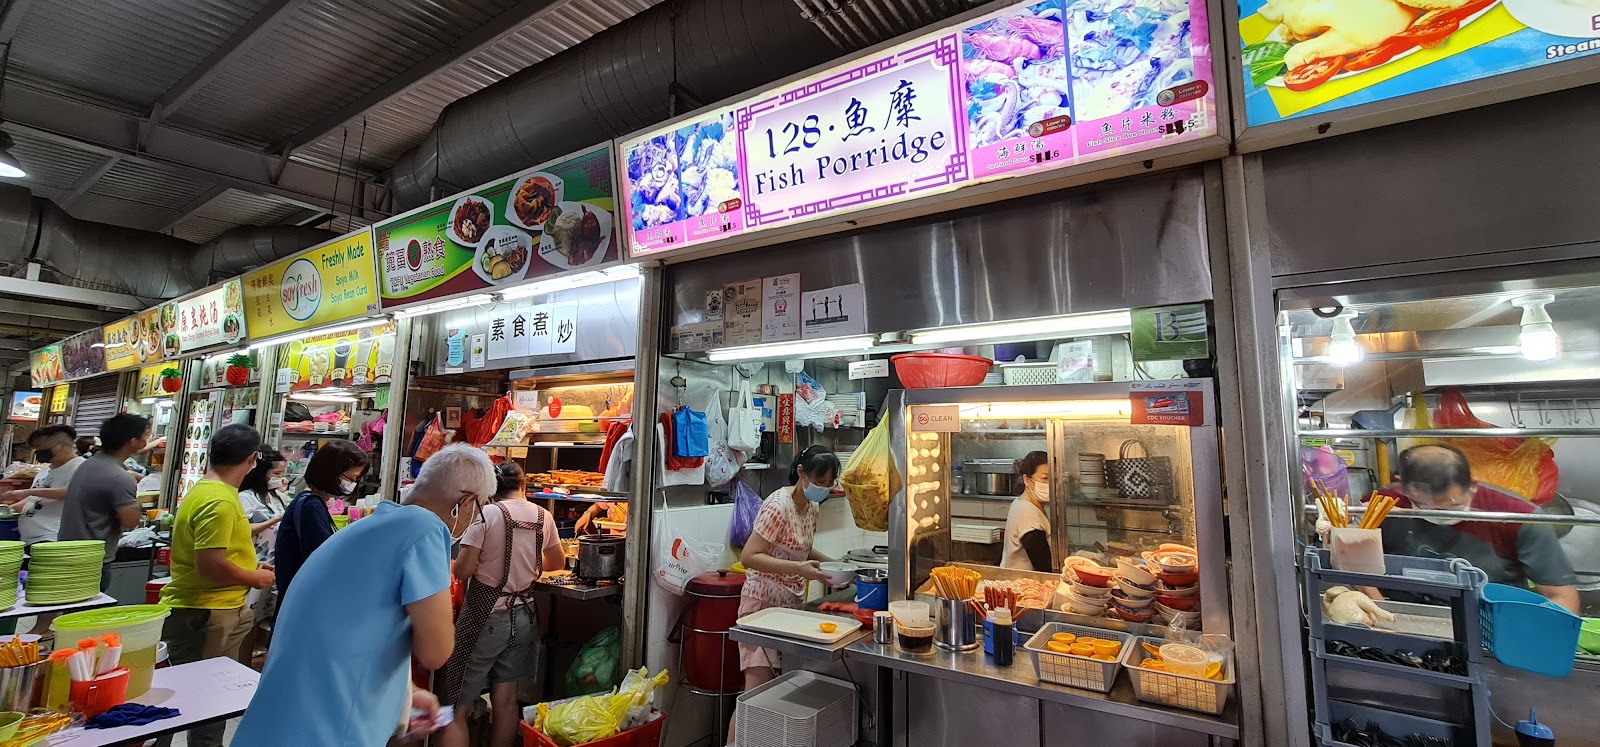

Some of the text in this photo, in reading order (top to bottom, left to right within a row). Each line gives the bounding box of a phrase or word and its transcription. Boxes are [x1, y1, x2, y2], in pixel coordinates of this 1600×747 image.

[1099, 108, 1178, 137] 魚片米粉
[1087, 139, 1103, 147] Fish
[1103, 135, 1121, 143] Slice
[755, 131, 946, 195] Fish Porridge
[321, 241, 365, 270] Freshly Made
[335, 270, 360, 286] Soya Milk
[403, 270, 430, 285] Vegetarian
[431, 265, 445, 278] Food
[331, 284, 368, 304] Soya Bean Curd
[491, 312, 574, 344] 素食煮炒
[1153, 311, 1180, 341] B
